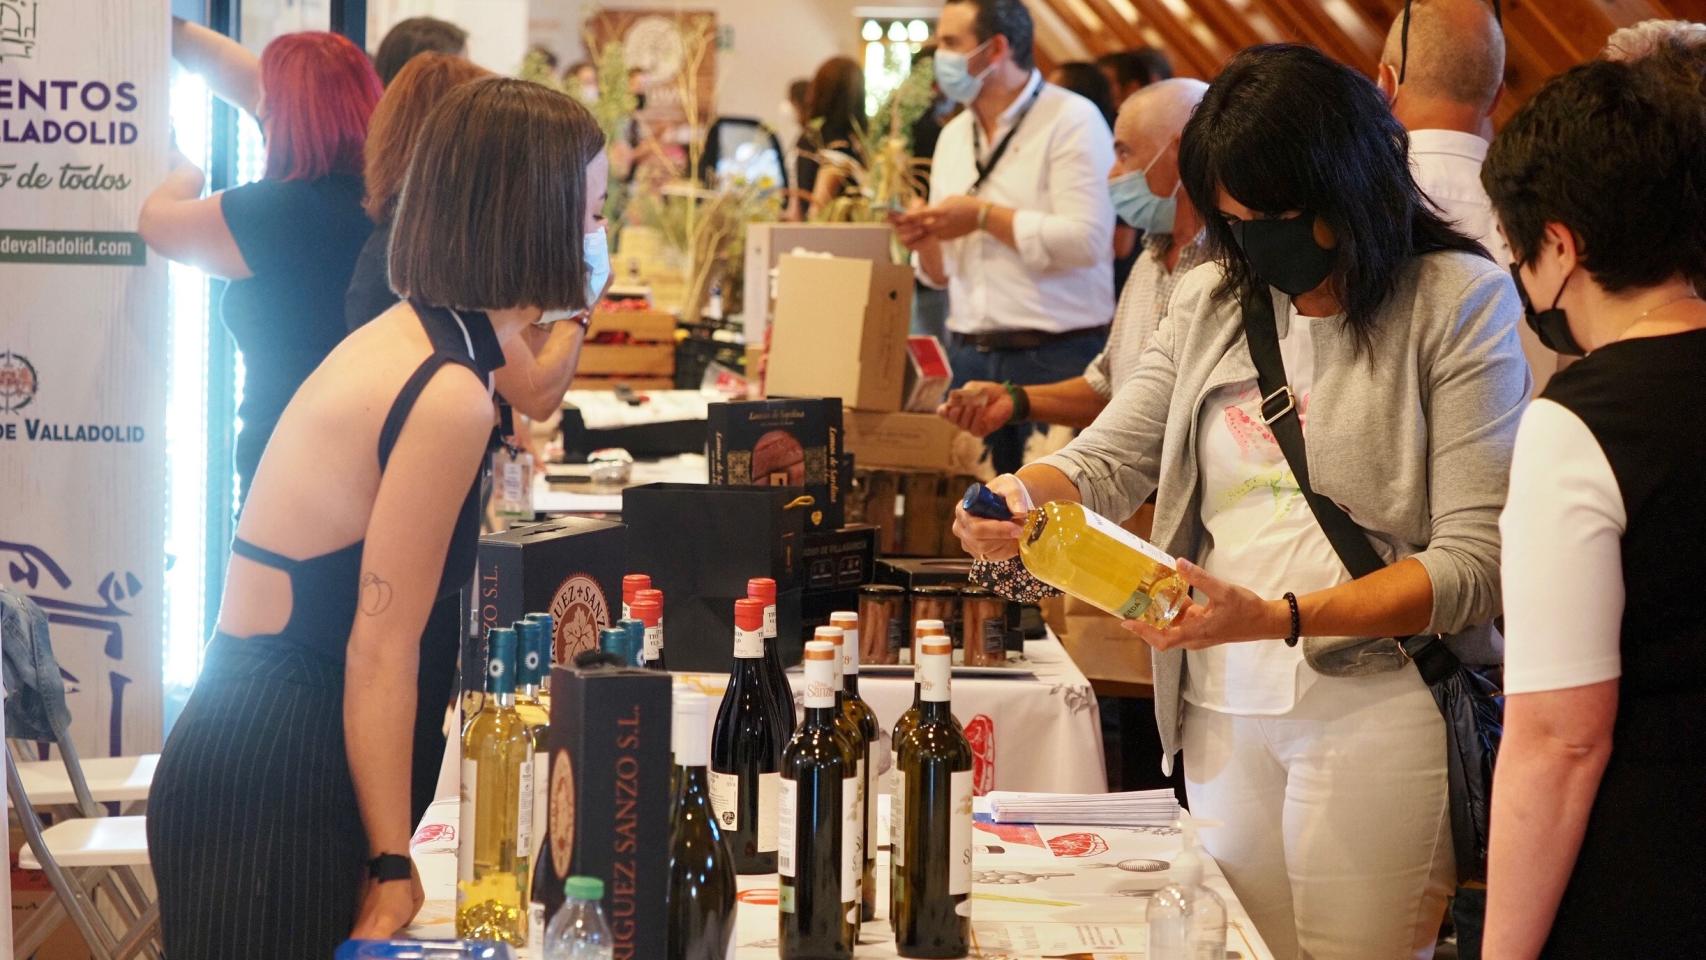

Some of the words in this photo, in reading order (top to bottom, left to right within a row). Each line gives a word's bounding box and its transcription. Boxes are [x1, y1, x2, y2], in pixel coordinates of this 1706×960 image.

[0, 79, 138, 112] ENTOS
[0, 120, 138, 145] LADOLID
[16, 162, 53, 190] de
[59, 163, 131, 191] todos
[483, 565, 498, 598] S.L.
[583, 585, 606, 633] SANZ
[617, 704, 641, 750] S.L.
[614, 756, 639, 853] SANZO
